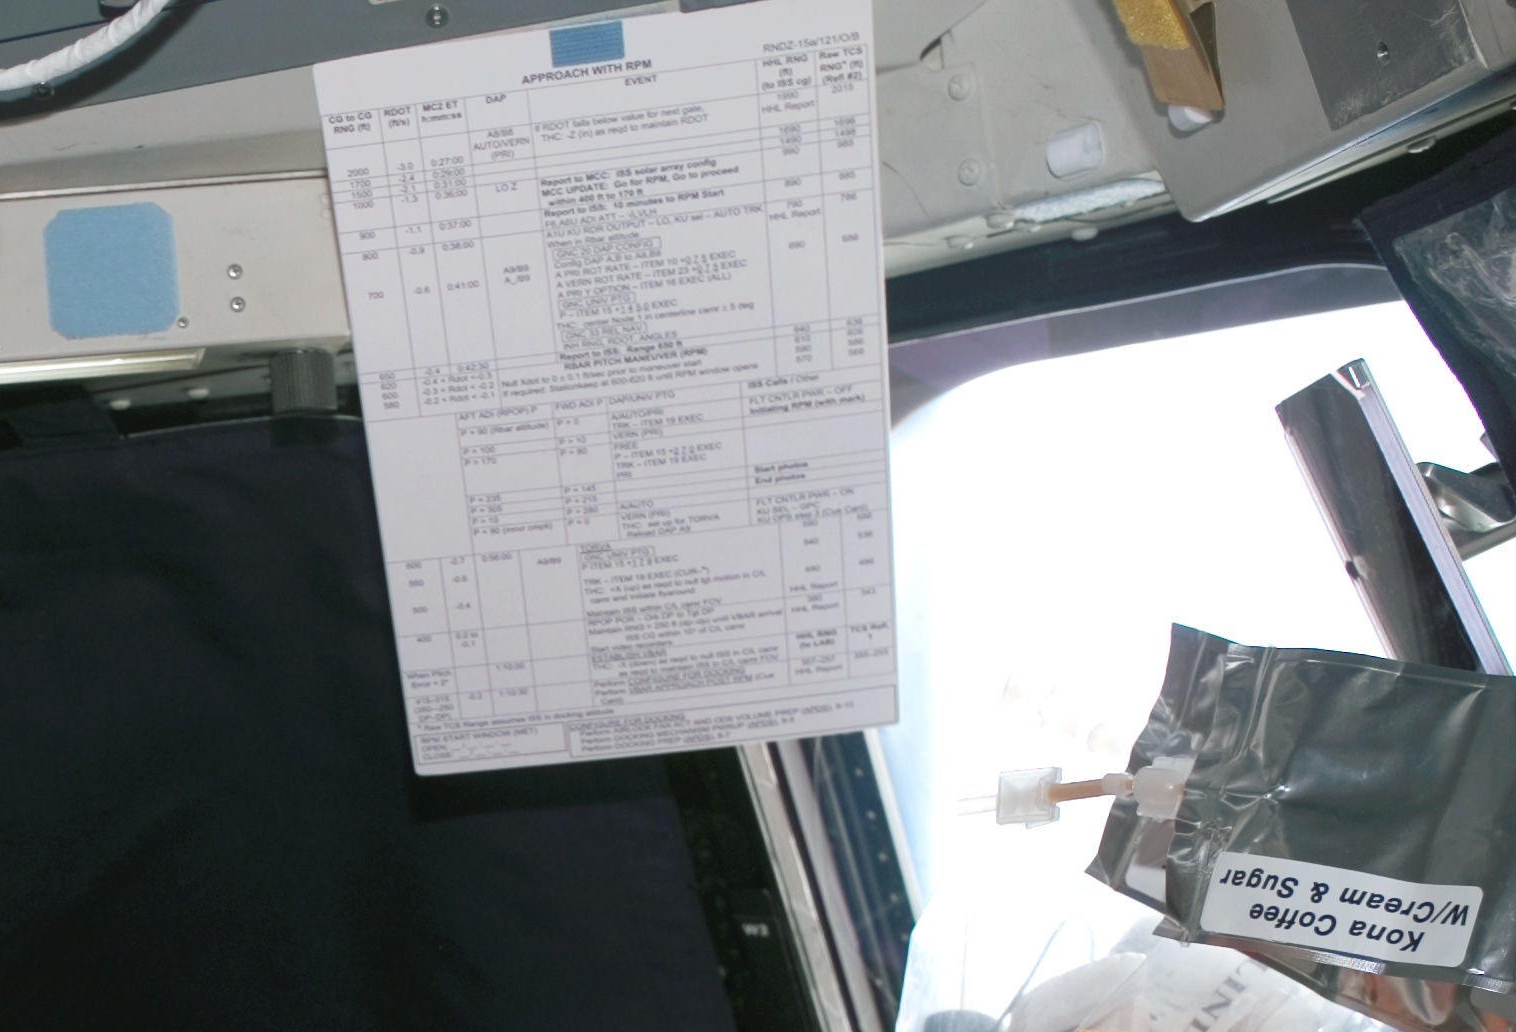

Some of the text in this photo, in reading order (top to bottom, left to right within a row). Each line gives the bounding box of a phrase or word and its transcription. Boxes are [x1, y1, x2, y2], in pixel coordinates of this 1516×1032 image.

[819, 51, 839, 60] Raw
[522, 60, 653, 85] APPROACH WITH RPM
[625, 75, 657, 86] EVENT
[486, 95, 506, 104] DAP
[446, 101, 458, 109] ET
[785, 100, 815, 111] Report
[384, 107, 411, 117] RDOT
[329, 112, 372, 124] CG to CG
[542, 122, 569, 132] RDOT
[592, 116, 618, 126] below
[621, 114, 644, 122] value
[647, 111, 658, 119] for
[660, 108, 680, 117] next
[334, 123, 370, 134] RNG (ft)
[541, 134, 564, 143] THC:
[608, 126, 628, 136] reqd
[641, 119, 678, 130] maintain
[681, 114, 708, 125] RDOT
[491, 151, 515, 160] (PRI)
[397, 162, 413, 171] -3.0
[431, 156, 464, 167] 0:27:00
[348, 168, 369, 177] 2000
[541, 158, 716, 187] Report to MCC: ISS solar array config
[399, 174, 415, 182] -2.4
[542, 187, 563, 196] MCC
[566, 182, 608, 194] UPDATE:
[614, 180, 628, 188] Go
[630, 177, 642, 186] for
[673, 172, 686, 180] Go
[689, 170, 698, 179] to
[701, 166, 739, 180] proceed
[350, 180, 371, 188] 1700
[509, 182, 517, 191] Z
[352, 190, 372, 198] 1500
[548, 196, 576, 206] within
[607, 191, 615, 200] to
[637, 188, 643, 196] ft
[353, 201, 374, 209] 1000
[544, 209, 574, 218] Report
[577, 206, 586, 214] to
[626, 196, 663, 208] minutes
[666, 195, 675, 203] to
[678, 191, 699, 200] RPM
[702, 188, 724, 198] Start
[405, 226, 421, 234] -1.1
[360, 232, 375, 240] 900
[447, 281, 479, 291] 0:41:00
[564, 360, 591, 370] RBAR
[594, 357, 621, 367] PITCH
[624, 351, 677, 363] MANEUVER
[1219, 868, 1469, 926] W/Cream & Sugar
[1249, 904, 1425, 951] Kona Coffee
